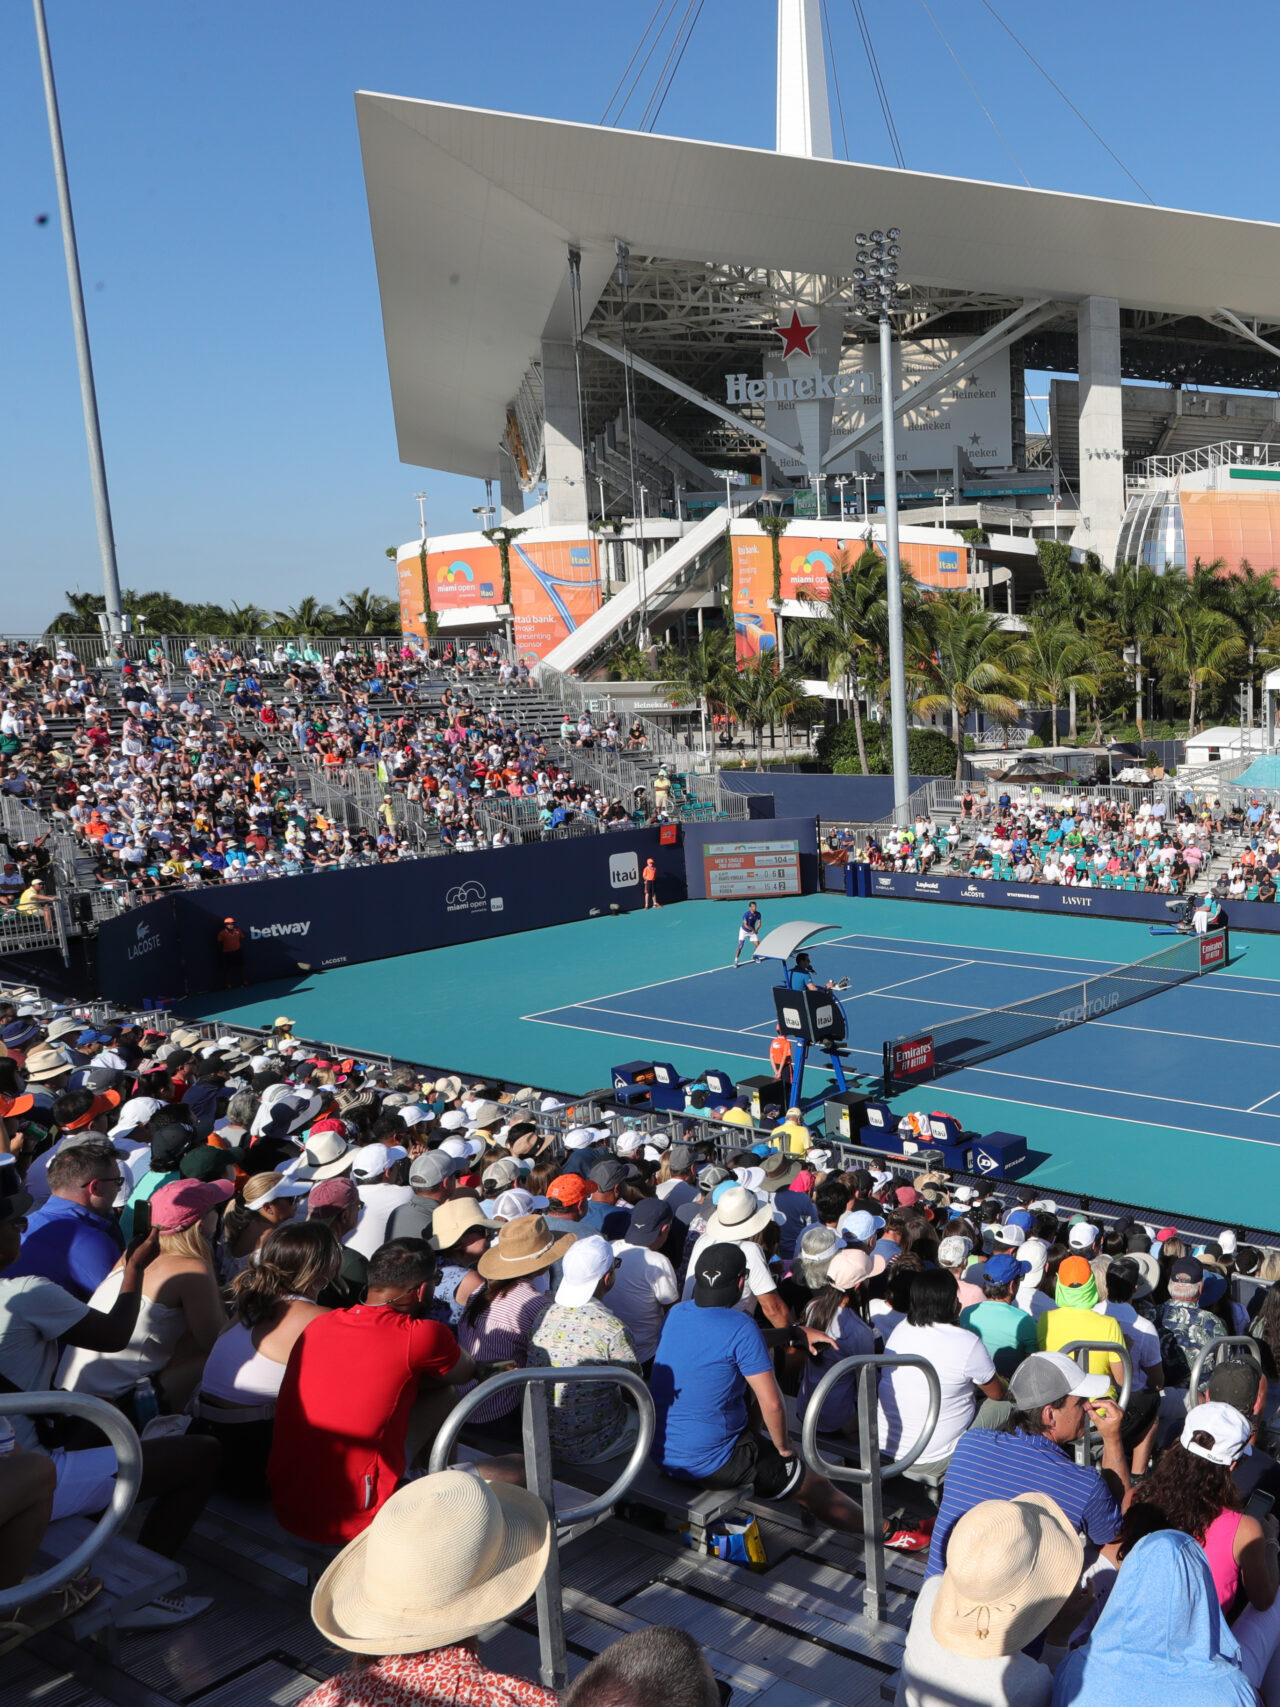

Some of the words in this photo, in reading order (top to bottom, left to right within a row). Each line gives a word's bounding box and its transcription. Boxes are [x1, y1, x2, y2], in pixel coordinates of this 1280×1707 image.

[725, 368, 875, 404] Heineken
[571, 555, 591, 565] Itaú
[939, 560, 958, 570] Itaú
[790, 574, 814, 583] miami
[437, 583, 457, 593] miami
[458, 583, 476, 594] open
[514, 615, 531, 624] Itaú
[532, 614, 556, 624] bank.
[515, 624, 535, 632] Proud
[515, 631, 552, 641] presenting
[515, 640, 543, 649] sponsor
[612, 868, 637, 883] Itaú
[447, 902, 469, 912] miami
[470, 900, 487, 909] open
[1062, 896, 1092, 906] LASVIT
[250, 920, 311, 940] betway
[127, 933, 161, 960] LACOSTE
[1202, 940, 1223, 953] Emirates
[321, 956, 347, 966] LACOSTE
[1086, 991, 1120, 1016] TOUR
[785, 1015, 800, 1026] Itaú
[817, 1014, 832, 1025] Itaú
[895, 1043, 932, 1062] Emirates
[910, 1054, 927, 1068] BETTER
[869, 1115, 883, 1125] Itaú
[932, 1128, 946, 1137] Itaú
